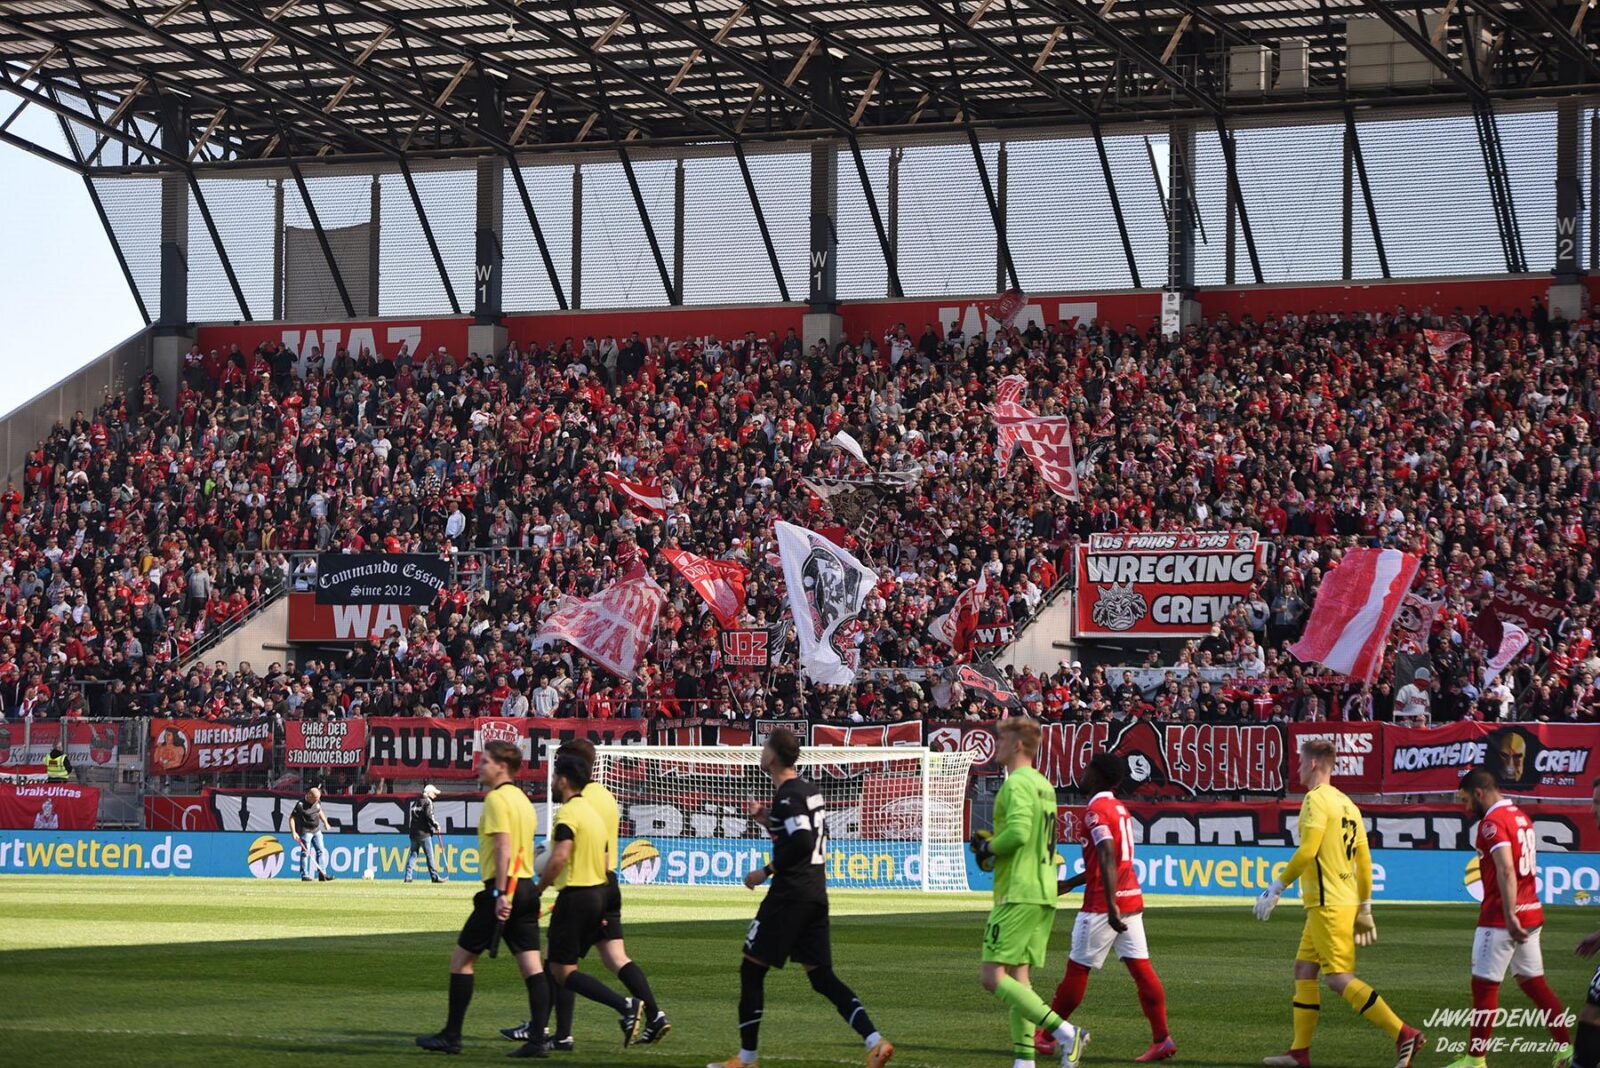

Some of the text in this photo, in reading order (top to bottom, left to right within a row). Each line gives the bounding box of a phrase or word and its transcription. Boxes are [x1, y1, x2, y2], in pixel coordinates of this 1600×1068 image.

[1557, 216, 1576, 235] W
[810, 250, 828, 267] W
[1559, 239, 1574, 260] 2
[476, 264, 492, 281] W
[814, 272, 822, 291] 1
[479, 286, 487, 304] 1
[1094, 536, 1124, 549] LOS
[319, 559, 445, 590] Commando Essen
[1086, 554, 1255, 583] WRECKING
[350, 584, 411, 597] Since 2012
[1152, 595, 1242, 624] CREW
[301, 721, 348, 736] EHRE DER
[304, 736, 342, 750] GRUPPE
[371, 727, 472, 767] RUDE
[199, 743, 265, 769] ESSEN
[1165, 722, 1284, 792] ESSENER
[1393, 742, 1589, 773] NORTHSIDE CREW
